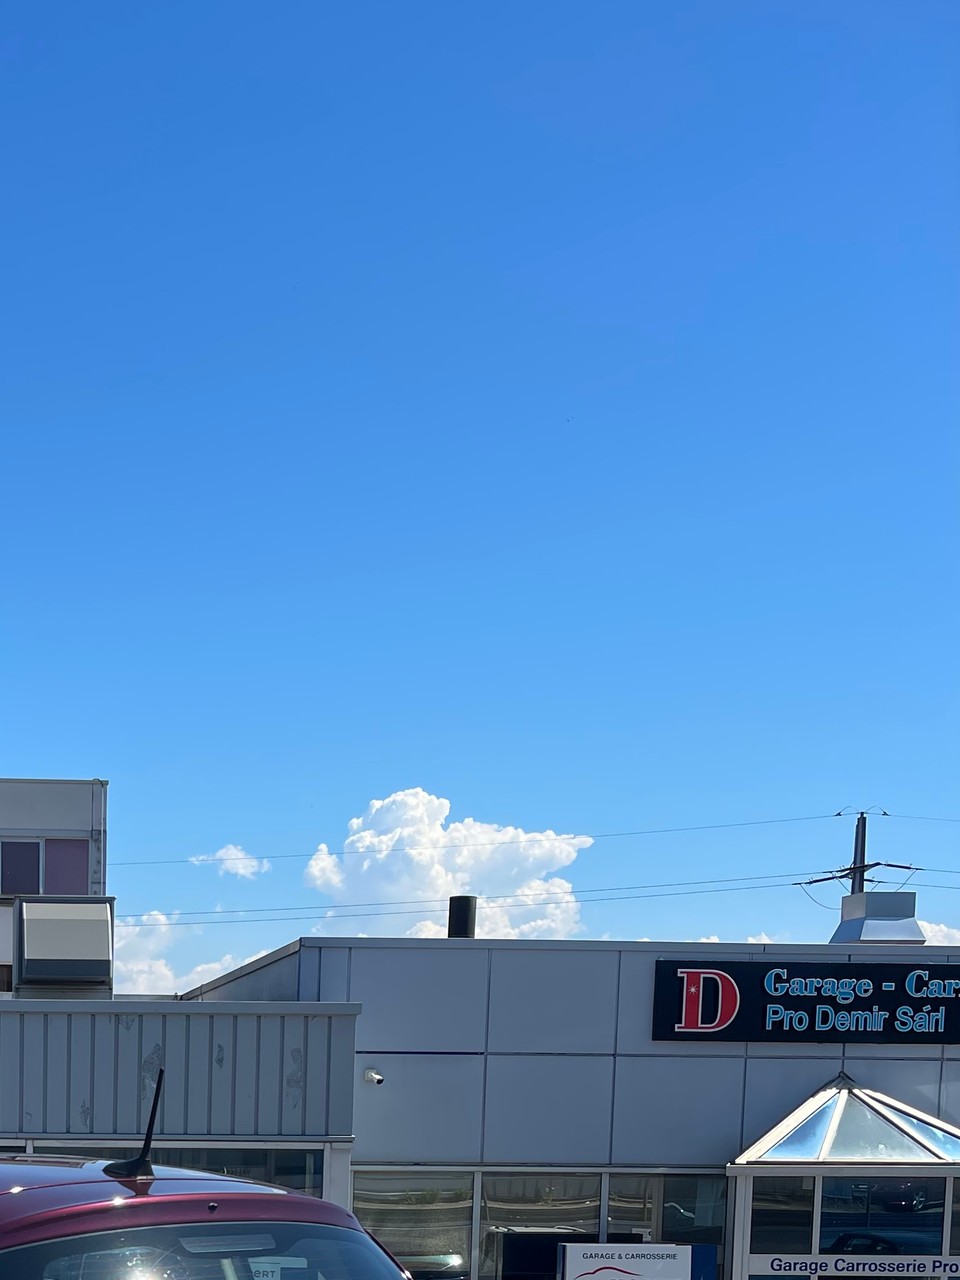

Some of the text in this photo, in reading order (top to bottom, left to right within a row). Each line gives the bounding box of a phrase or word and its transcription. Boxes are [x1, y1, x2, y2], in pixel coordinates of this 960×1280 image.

[674, 968, 740, 1032] D
[764, 967, 874, 1005] Garage
[905, 970, 960, 998] Car
[765, 1004, 945, 1032] Pro Demir Sárl
[582, 1252, 678, 1260] GARAGE & CARROSSERIE
[770, 1258, 960, 1274] Garage Carrosserie Pro
